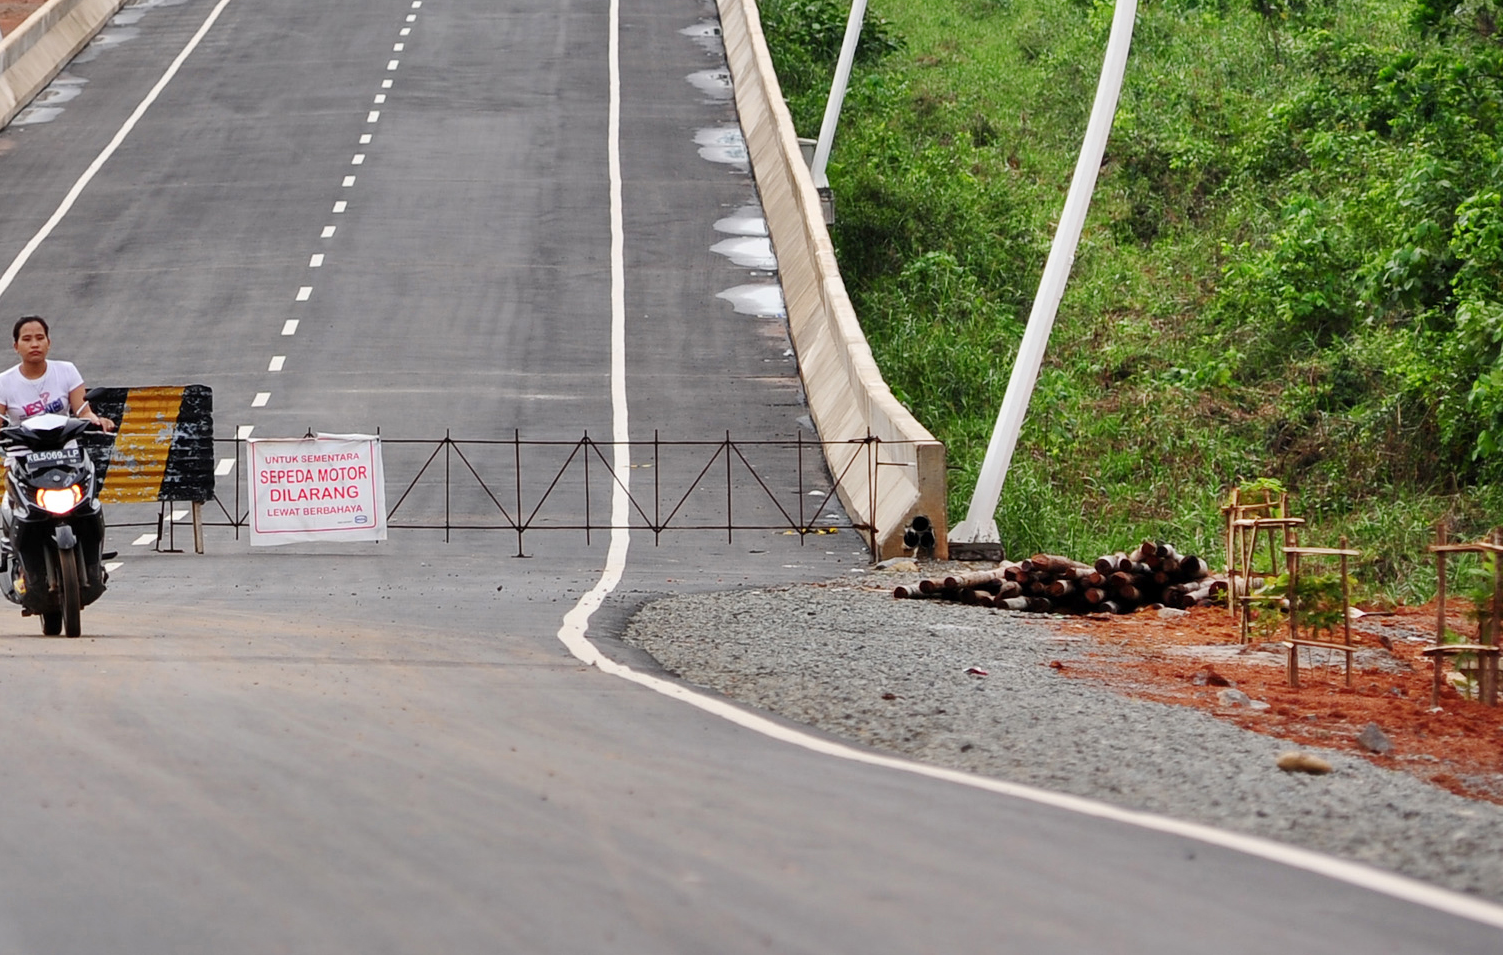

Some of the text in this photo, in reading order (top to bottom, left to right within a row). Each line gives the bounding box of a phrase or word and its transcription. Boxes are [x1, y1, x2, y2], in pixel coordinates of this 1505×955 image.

[40, 451, 63, 460] 5069
[67, 449, 79, 458] LP
[265, 452, 360, 464] UNTUK SEMENTARA
[260, 466, 367, 484] SEPEDA MOTOR
[270, 485, 359, 502] DILARANG
[267, 504, 363, 517] LEWAT BERBAHAYA
